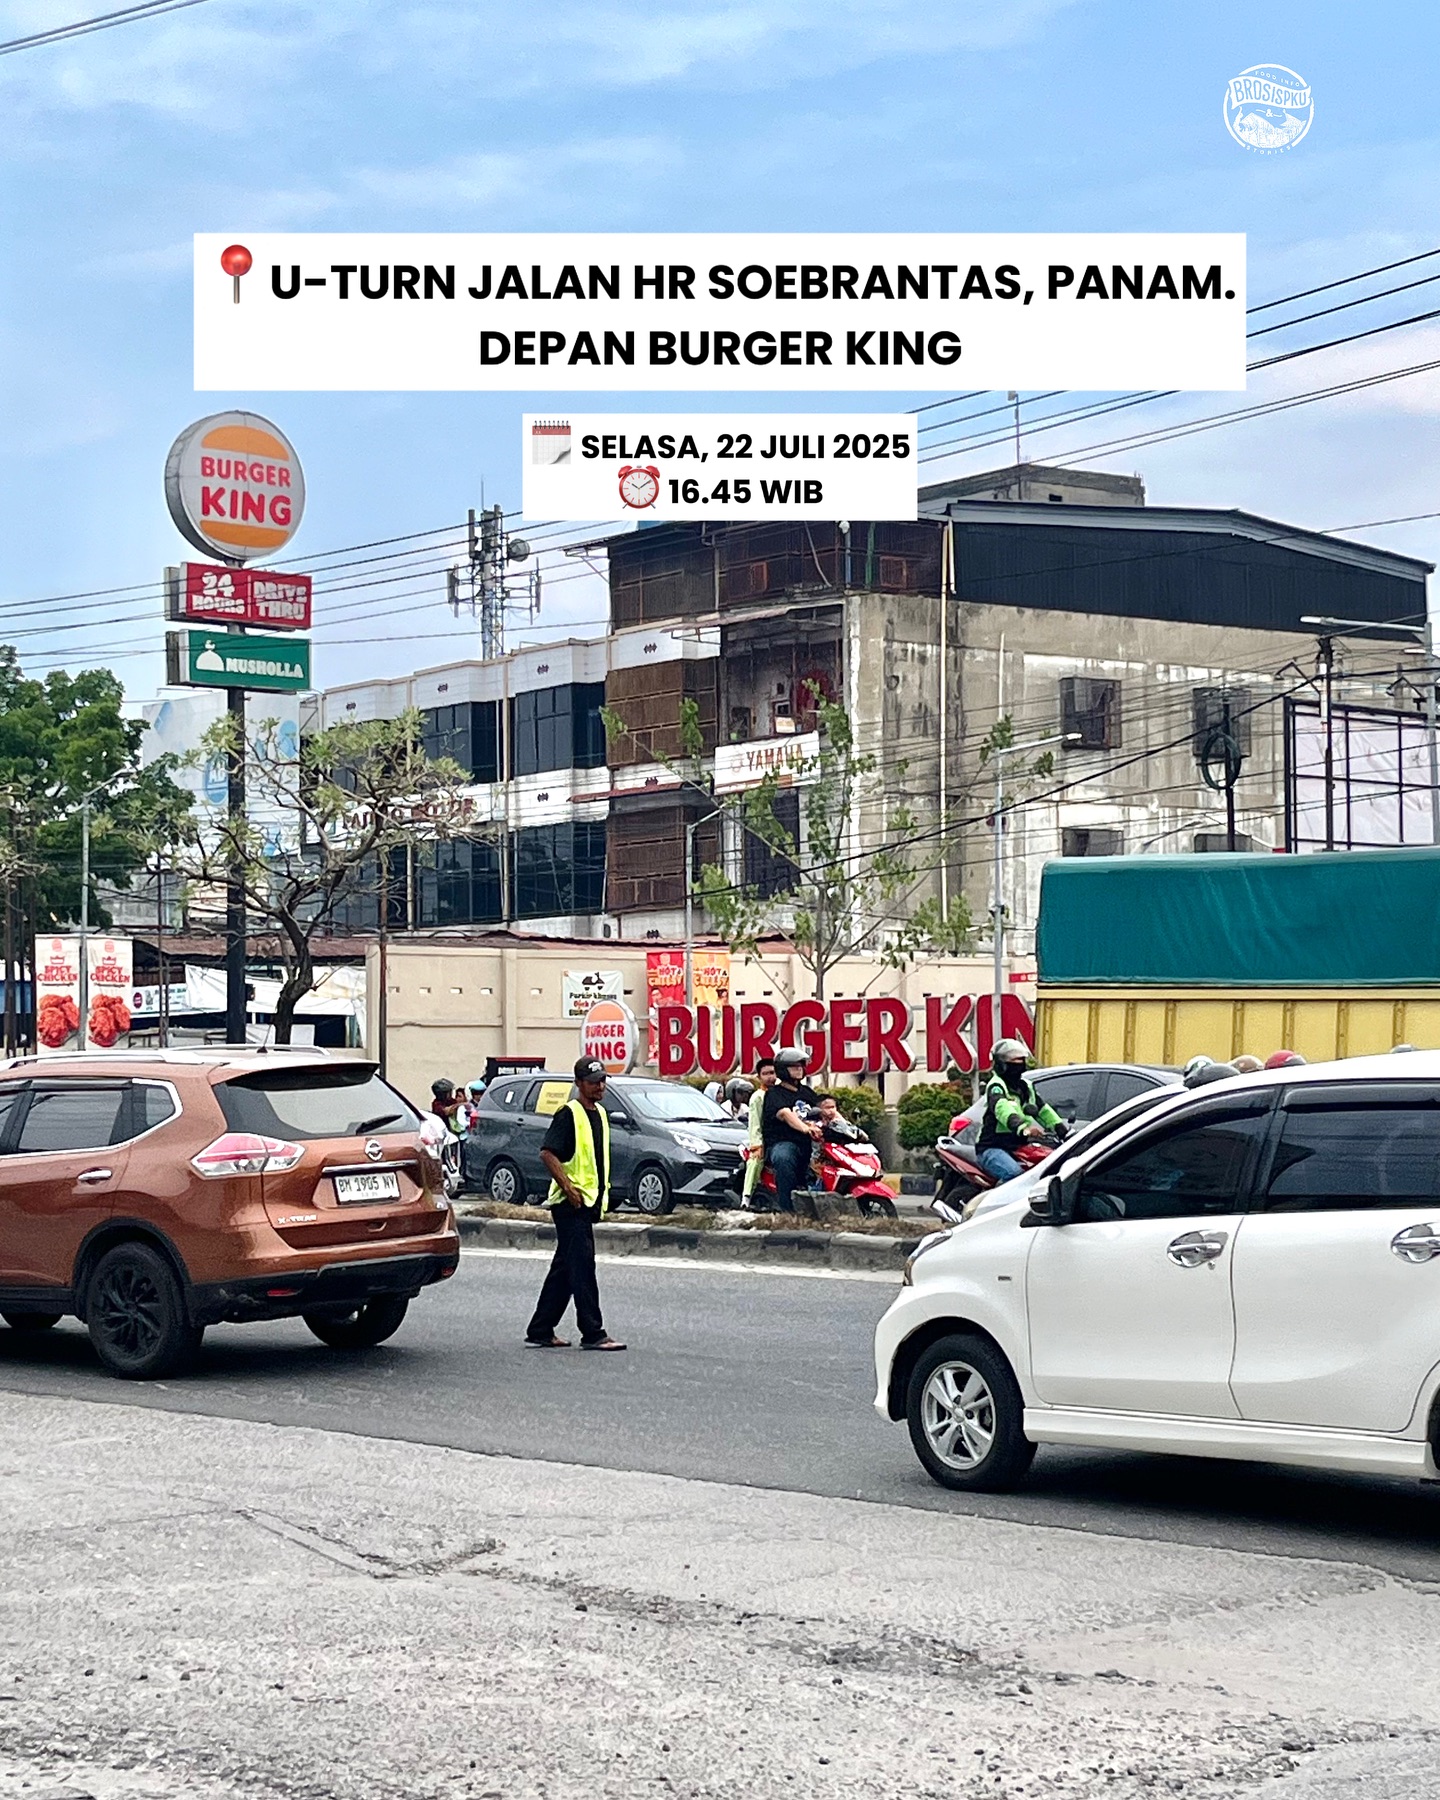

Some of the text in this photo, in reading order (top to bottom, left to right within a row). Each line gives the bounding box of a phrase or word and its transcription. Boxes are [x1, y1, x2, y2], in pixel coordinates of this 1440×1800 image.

[200, 456, 291, 488] BURGER
[201, 485, 292, 526] KING
[202, 572, 235, 597] 24
[253, 581, 307, 603] DRIVE
[192, 594, 245, 614] HOURS
[255, 600, 305, 620] THRU
[226, 658, 304, 679] MUSHOLLA
[90, 973, 131, 983] CHICKEN
[585, 1024, 625, 1039] BURGER
[657, 997, 917, 1077] BURGER
[585, 1041, 626, 1060] KING
[338, 1178, 352, 1193] BM
